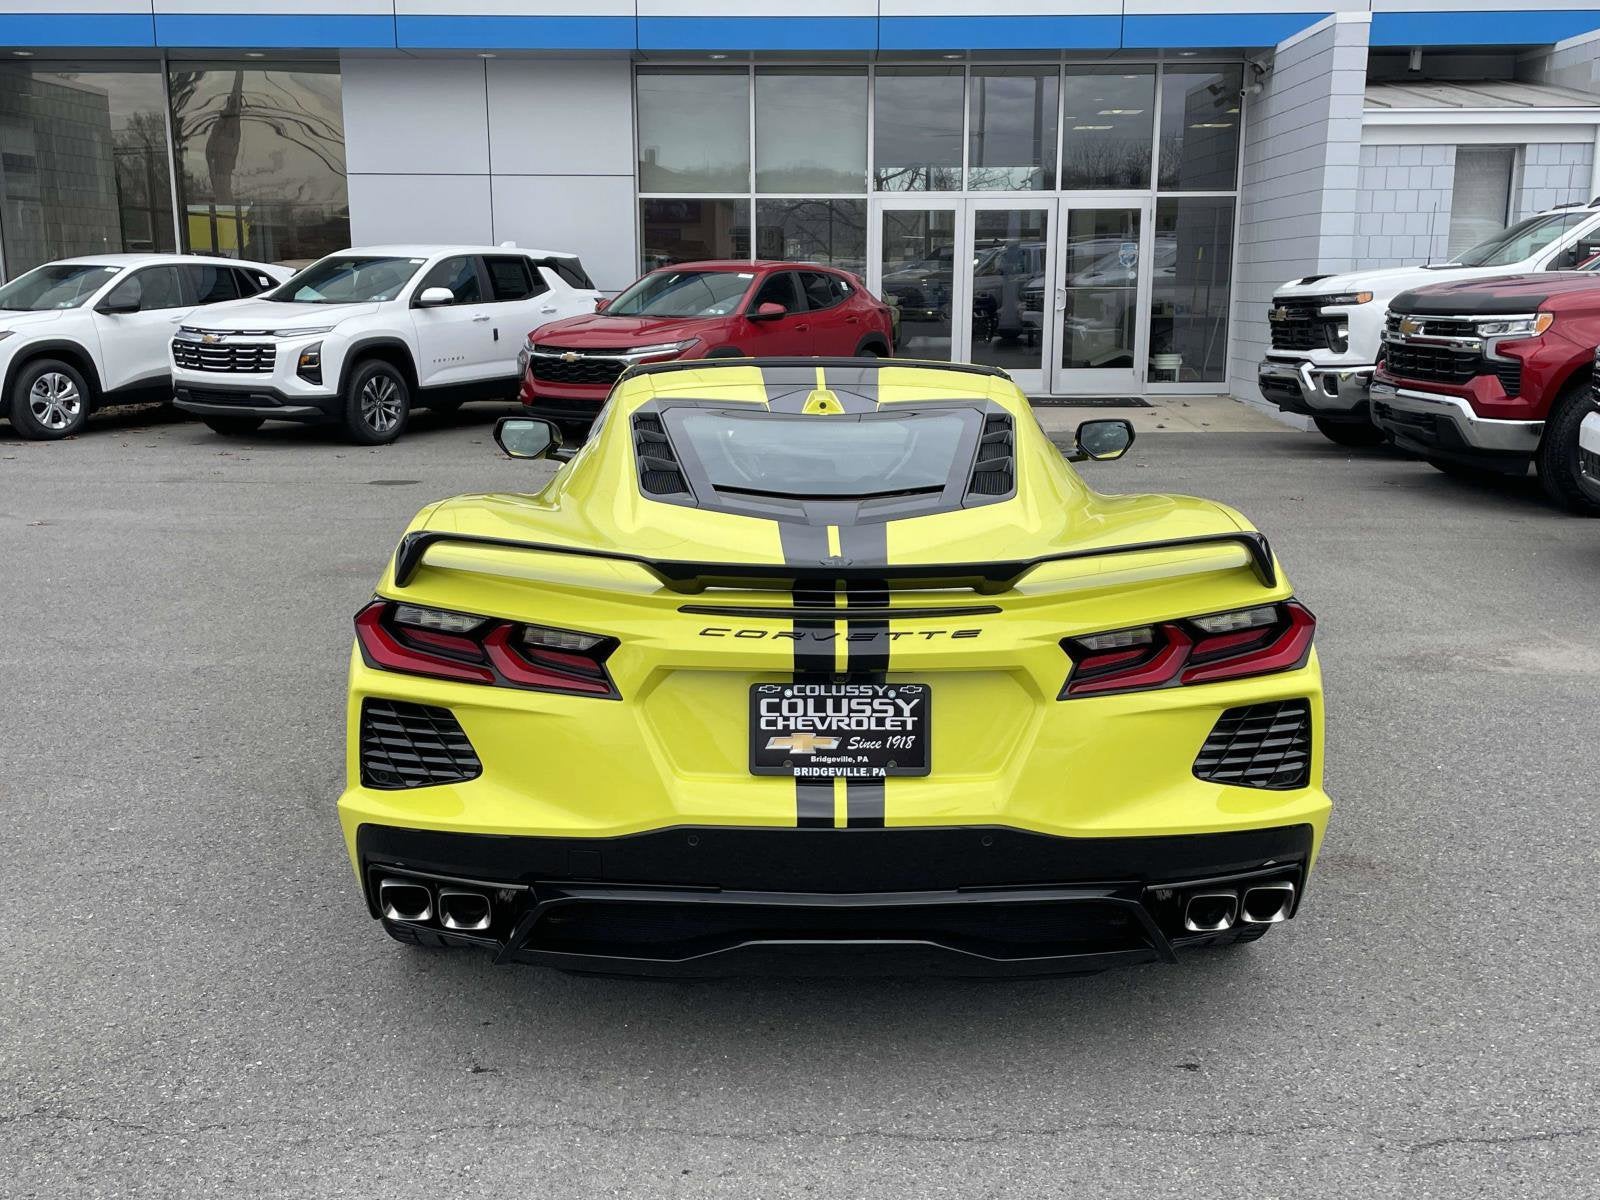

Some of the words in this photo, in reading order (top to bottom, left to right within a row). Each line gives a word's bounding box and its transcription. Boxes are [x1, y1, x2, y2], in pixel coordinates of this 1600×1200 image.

[699, 627, 983, 641] CORVETTE
[793, 685, 888, 696] COLUSSY
[760, 698, 920, 717] COLUSSY
[760, 717, 918, 731] CHEVROLET
[847, 736, 882, 750] Since
[886, 735, 916, 749] 1918
[810, 755, 856, 764] Bridgeville,
[857, 755, 869, 763] PA
[872, 767, 887, 777] PA
